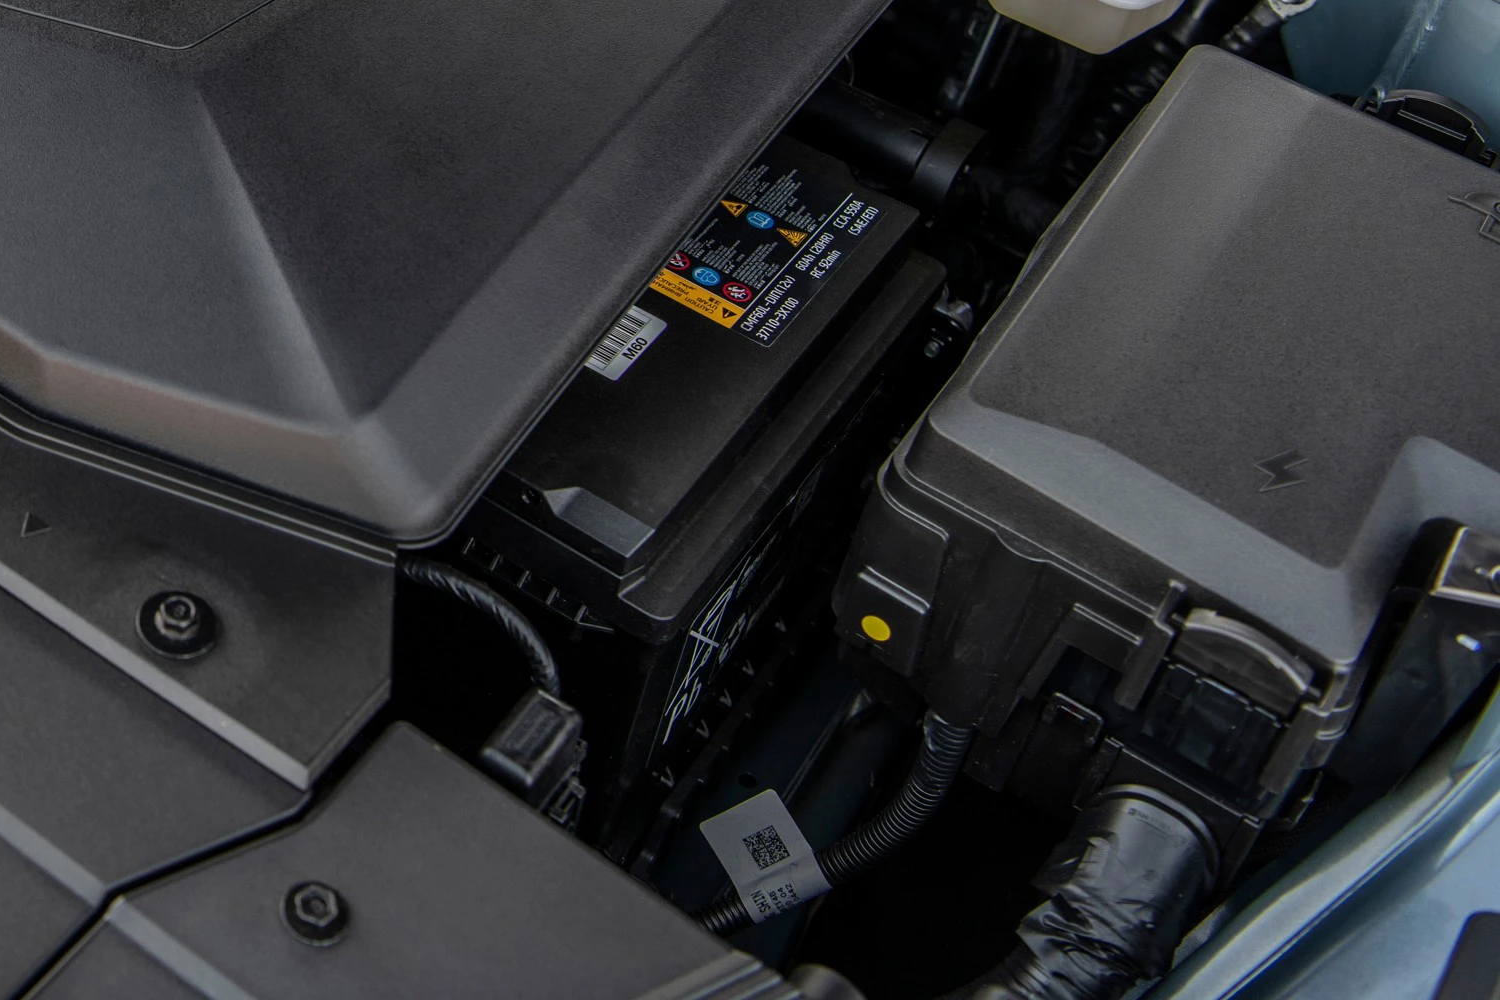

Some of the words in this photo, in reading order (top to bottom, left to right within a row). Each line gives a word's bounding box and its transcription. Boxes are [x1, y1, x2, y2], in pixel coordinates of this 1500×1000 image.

[796, 253, 815, 271] 60Ah
[810, 233, 834, 255] (20HR)
[833, 214, 851, 228] CCA
[848, 200, 864, 217] 550A
[685, 297, 714, 314] CAUTION
[696, 297, 718, 310] UYARI
[756, 298, 799, 340] 37110-3X100
[810, 266, 825, 278] RC
[820, 250, 841, 269] 92min
[622, 337, 648, 360] M60
